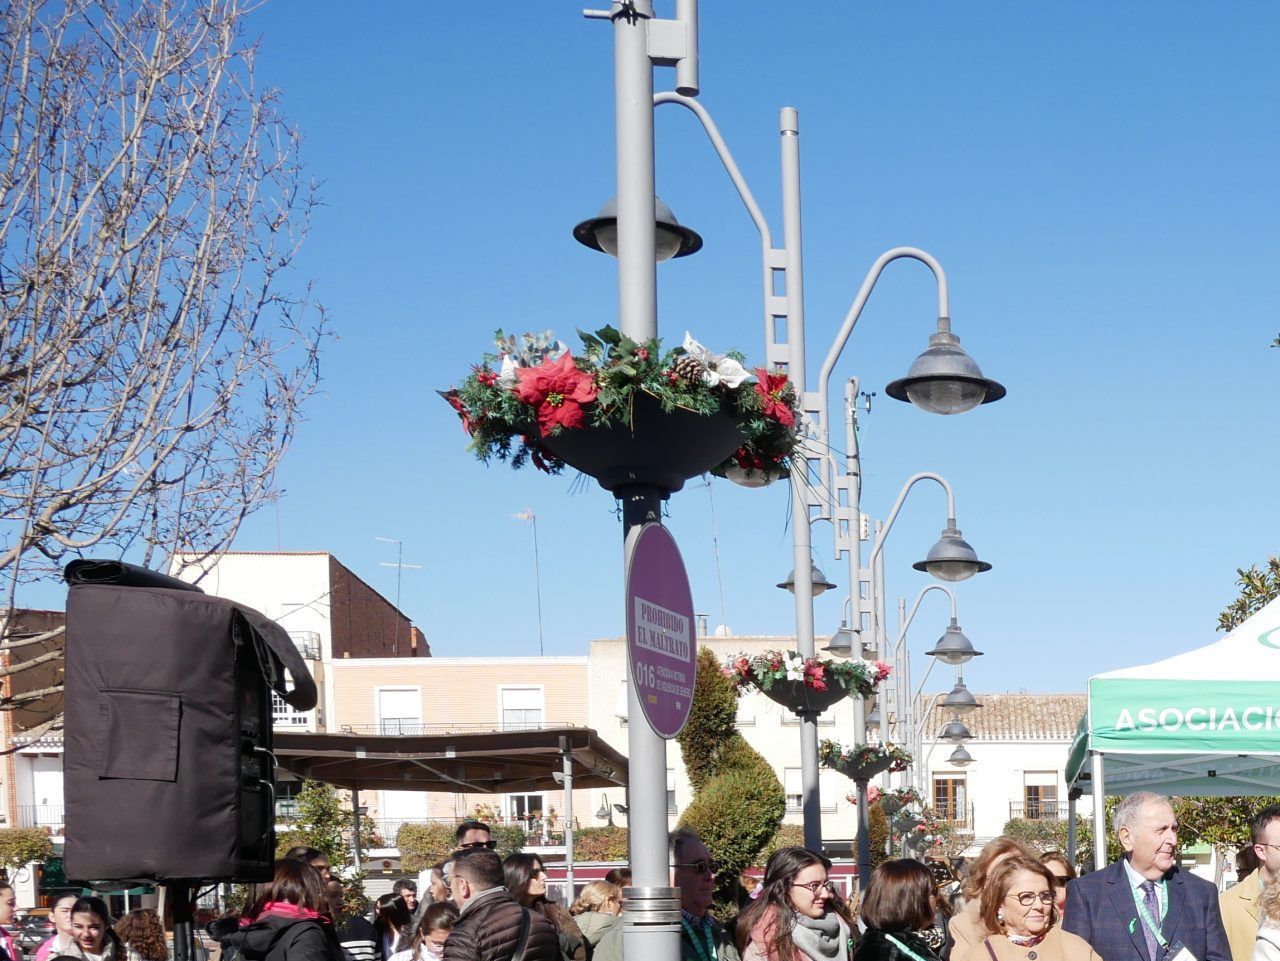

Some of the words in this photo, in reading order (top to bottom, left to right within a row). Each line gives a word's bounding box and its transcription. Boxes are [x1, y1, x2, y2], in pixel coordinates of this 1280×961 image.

[641, 602, 684, 634] PROHIBIDO
[638, 625, 648, 645] EL
[649, 629, 688, 658] MALTRATO
[636, 661, 655, 688] 016
